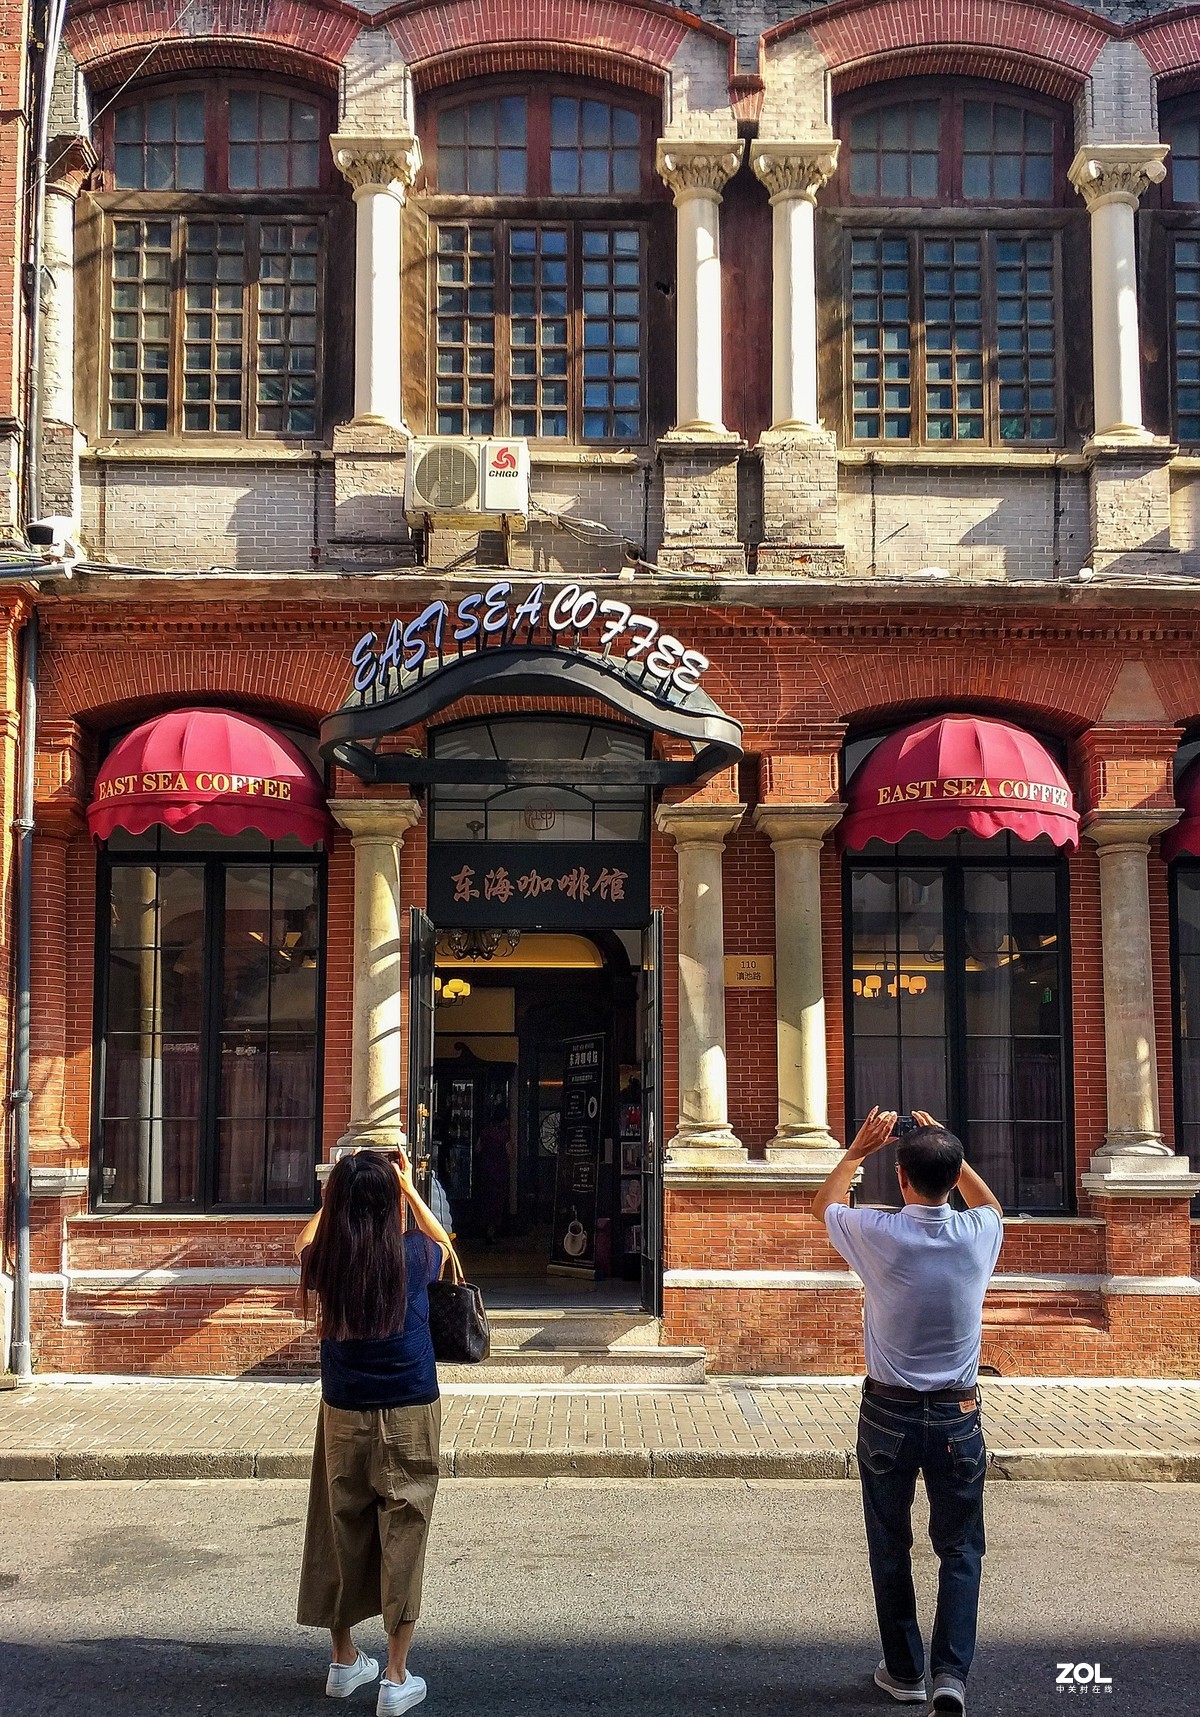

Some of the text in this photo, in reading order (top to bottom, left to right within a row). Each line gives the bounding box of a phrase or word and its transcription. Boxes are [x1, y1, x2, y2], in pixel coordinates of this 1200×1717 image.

[488, 470, 519, 478] CHIGO
[352, 581, 710, 693] EAST SEA COFFEE
[98, 772, 292, 800] EAST SEA COFFEE
[876, 778, 1069, 808] EAST SEA COFFEE
[451, 864, 629, 902] 东海咖啡馆
[740, 960, 757, 969] 110
